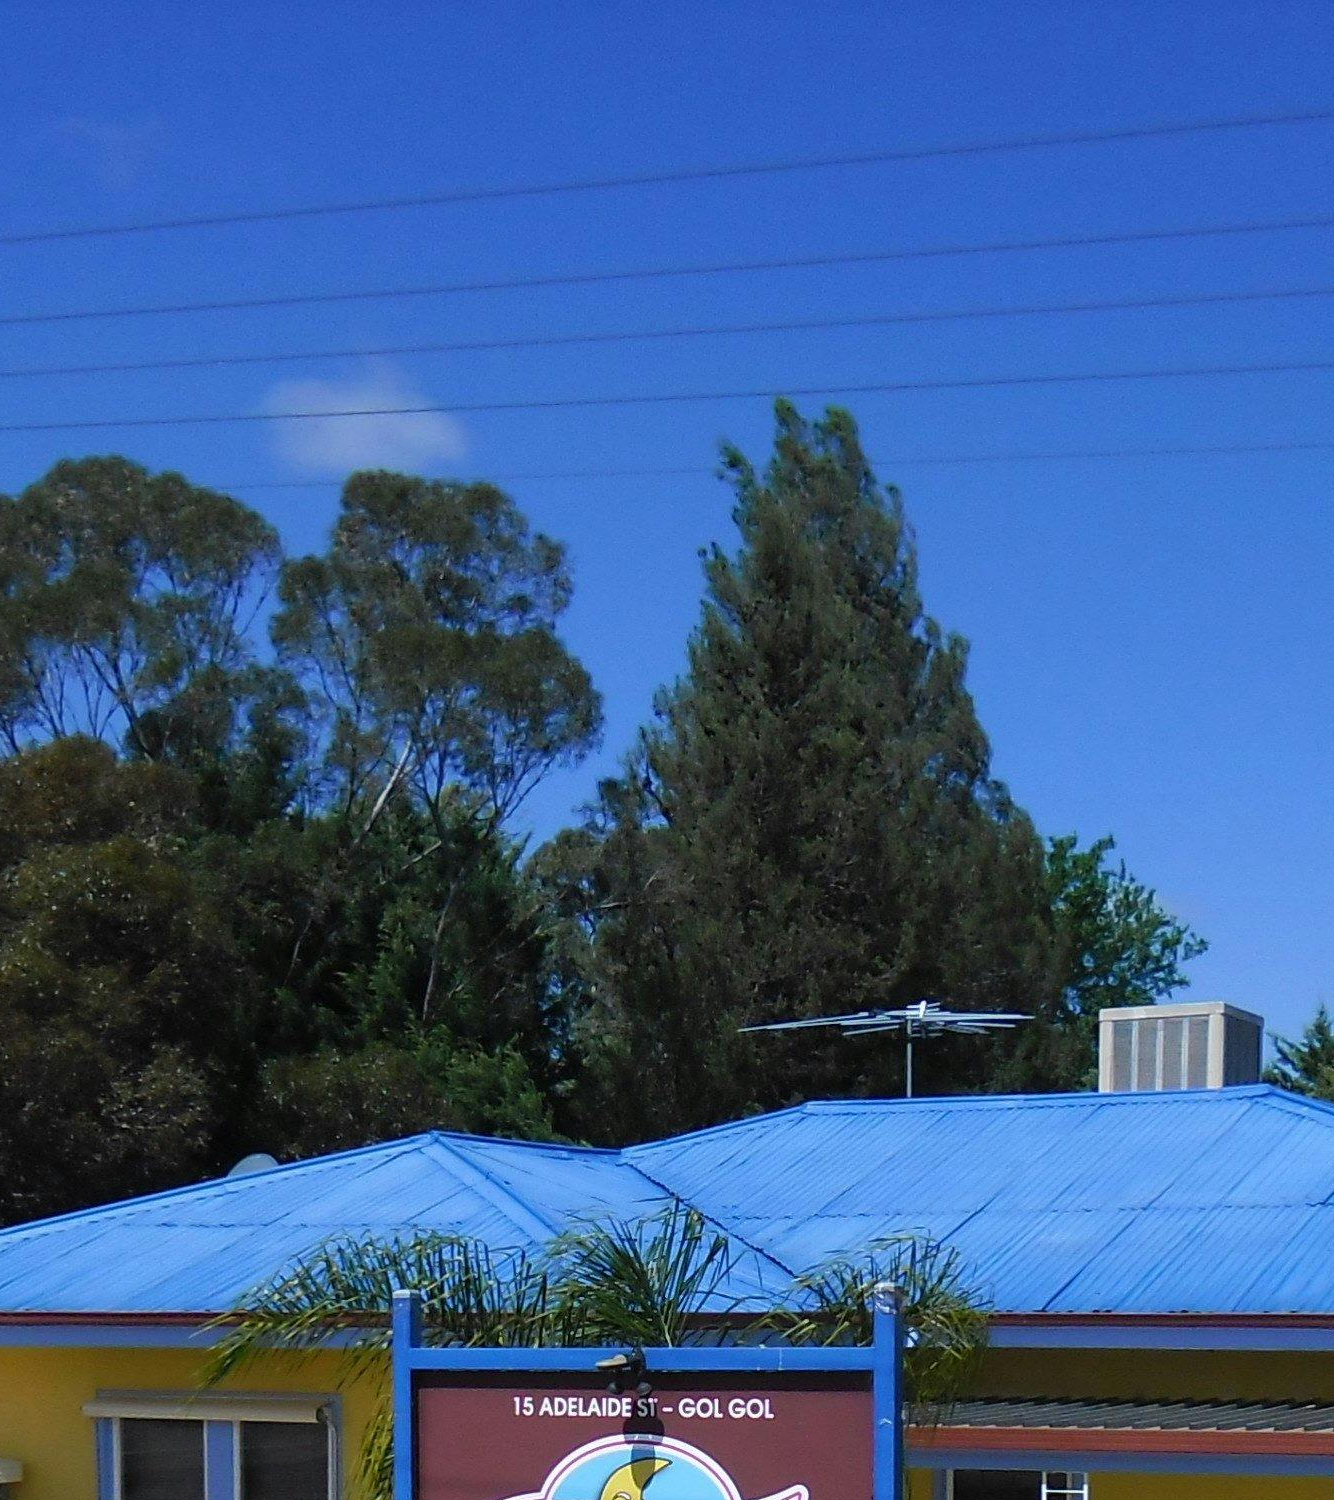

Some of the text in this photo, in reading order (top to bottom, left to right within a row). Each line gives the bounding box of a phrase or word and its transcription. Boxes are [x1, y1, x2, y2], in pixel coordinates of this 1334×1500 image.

[513, 1396, 534, 1416] 15
[539, 1396, 632, 1418] ADELAIDE
[637, 1397, 658, 1418] ST
[678, 1398, 723, 1418] GOL
[728, 1398, 774, 1419] GOL
